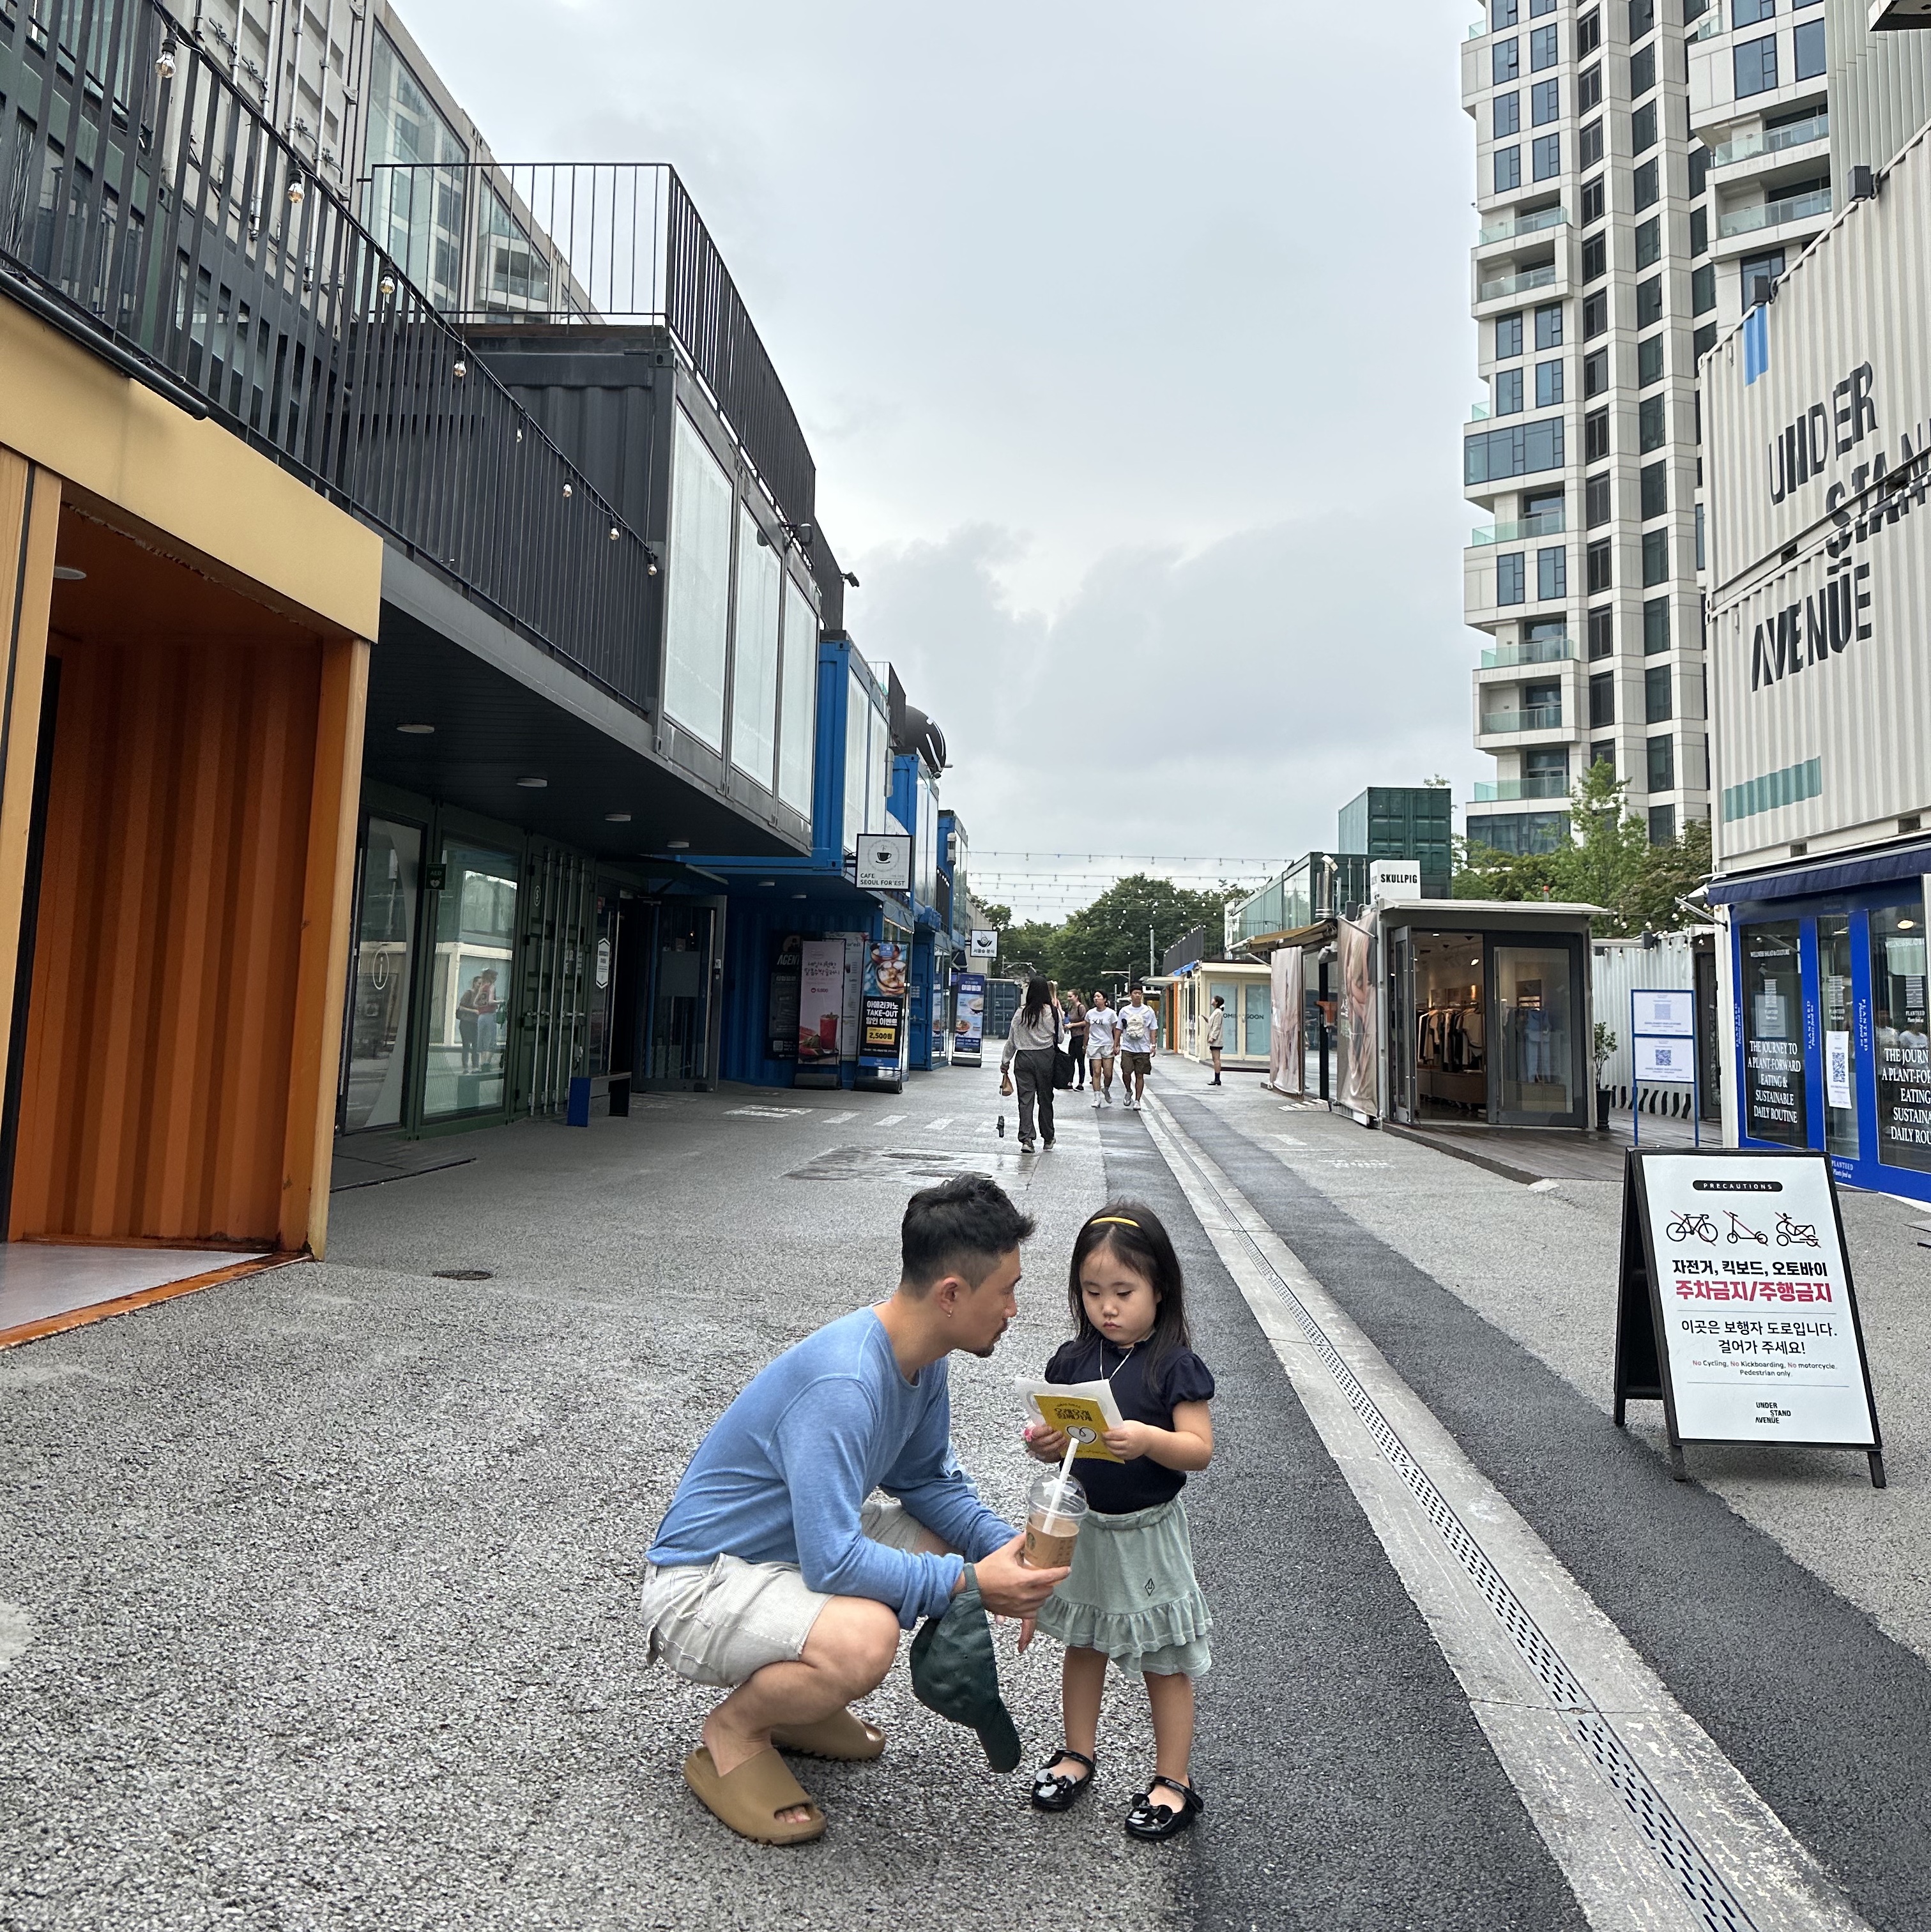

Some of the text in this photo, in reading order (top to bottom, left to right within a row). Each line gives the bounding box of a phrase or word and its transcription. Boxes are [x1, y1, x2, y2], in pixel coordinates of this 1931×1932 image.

[1769, 361, 1879, 505] UNDER
[1826, 418, 1931, 558] STAN
[1380, 874, 1417, 883] SKULLPIG
[866, 1000, 899, 1009] 아메리카노
[867, 1009, 899, 1017] TAKE-OUT
[866, 1017, 897, 1026] 할인 이벤트
[1750, 1040, 1798, 1055] THE JOURNEY TO
[1884, 1048, 1901, 1062] THE
[1748, 1056, 1801, 1072] A PLANT-FORWARD
[1760, 1074, 1788, 1088] EATING &
[1882, 1067, 1888, 1081] A
[1755, 1089, 1794, 1106] SUSTAINABLE
[1900, 1088, 1931, 1104] EATING
[1753, 1105, 1798, 1123] DAILY ROUTINE
[1890, 1126, 1914, 1142] DAILY
[1831, 1160, 1854, 1171] PLANTEED
[1672, 1259, 1828, 1277] 자전거, 킥보드, 오토바이
[1675, 1280, 1833, 1302] 주차금지/주행금지
[1681, 1320, 1838, 1337] 이곳은 보행자 도로입니다.
[1718, 1339, 1806, 1355] 걸어가 주세요!
[1741, 1361, 1786, 1369] Kickboarding,
